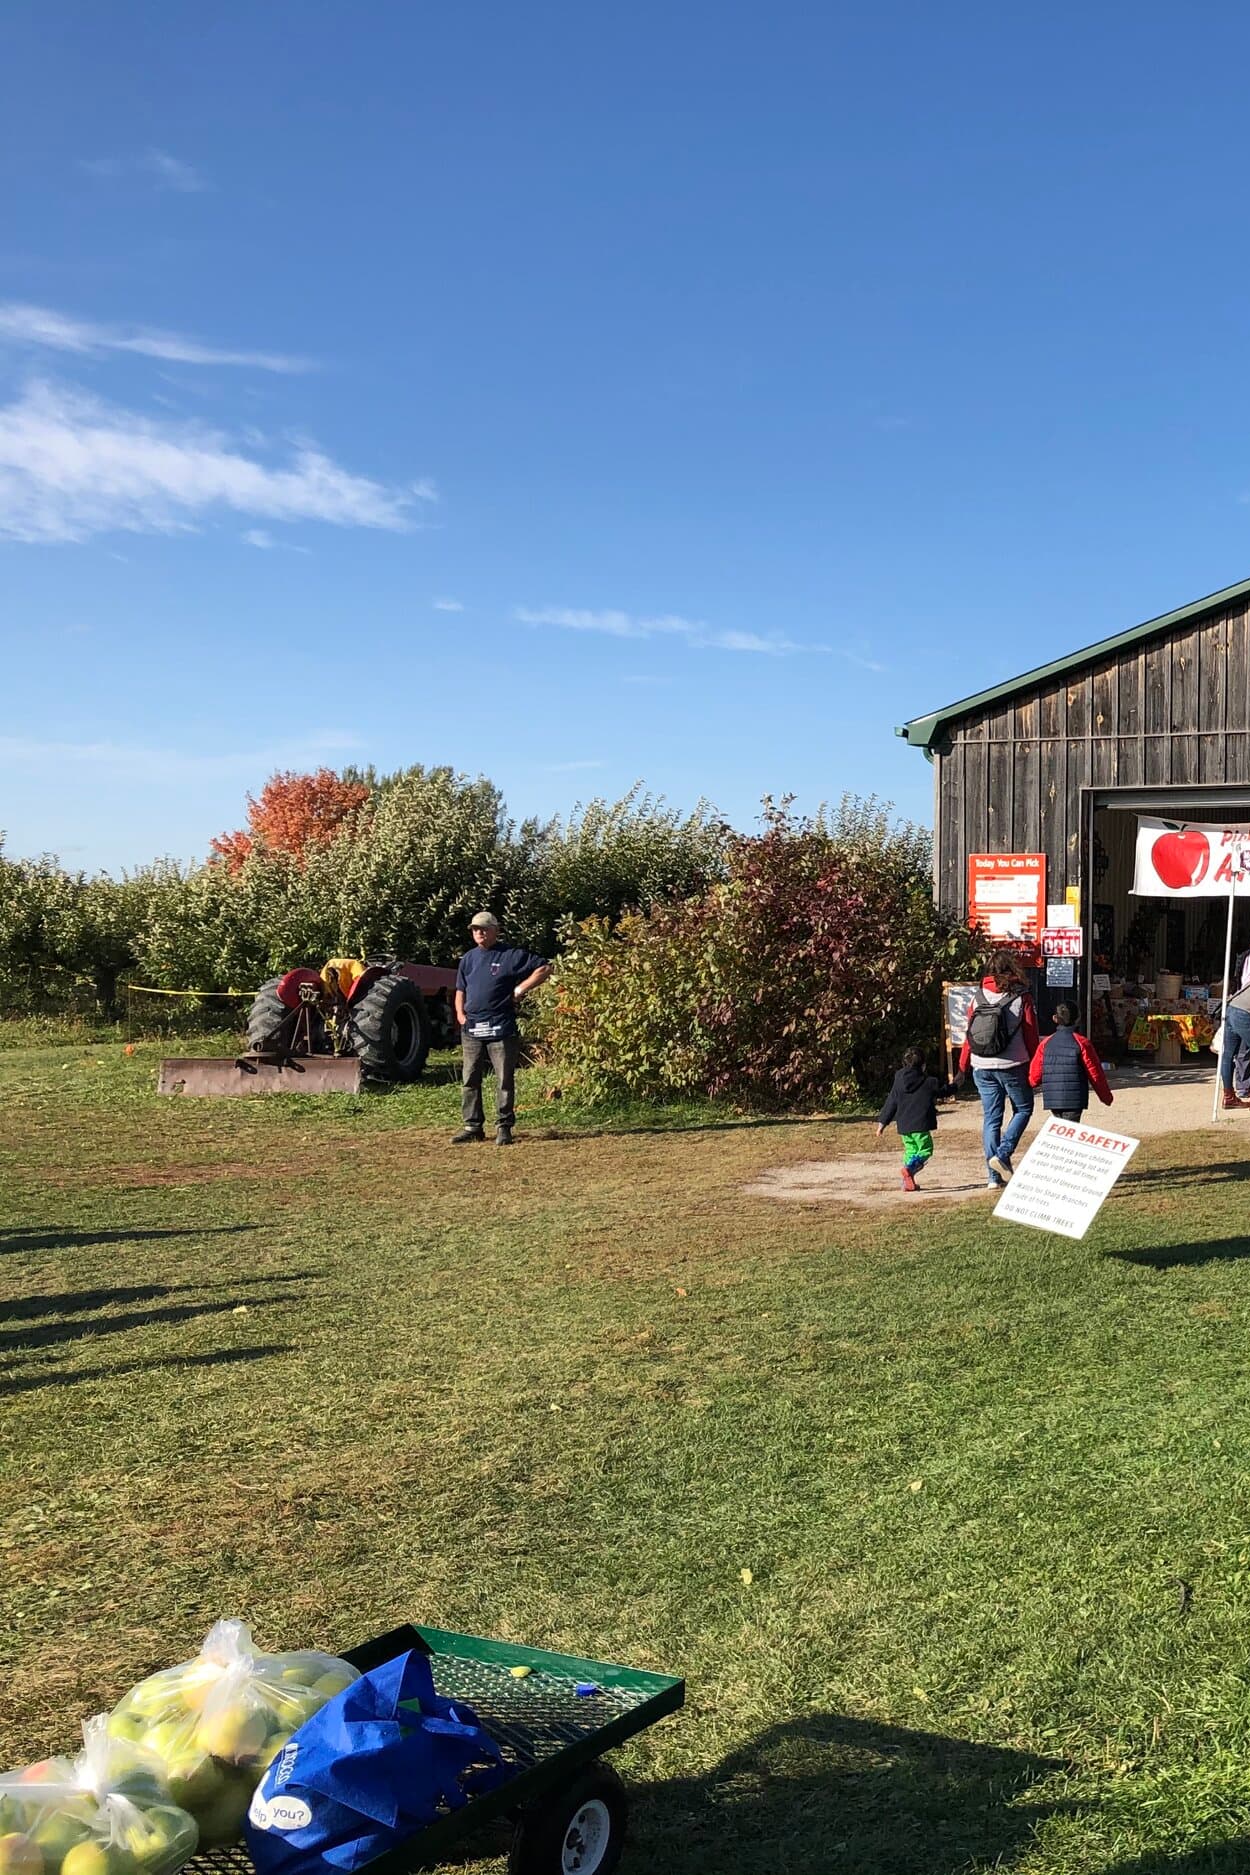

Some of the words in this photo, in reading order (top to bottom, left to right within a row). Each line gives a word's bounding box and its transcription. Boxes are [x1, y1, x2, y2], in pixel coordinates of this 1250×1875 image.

[975, 859, 995, 869] Today
[997, 859, 1009, 867] You
[1011, 859, 1024, 867] Can
[1025, 858, 1040, 867] Pick
[1044, 939, 1080, 954] OPEN
[1048, 1123, 1075, 1137] FOR
[1078, 1131, 1130, 1153] SAFETY
[273, 1807, 305, 1821] you?
